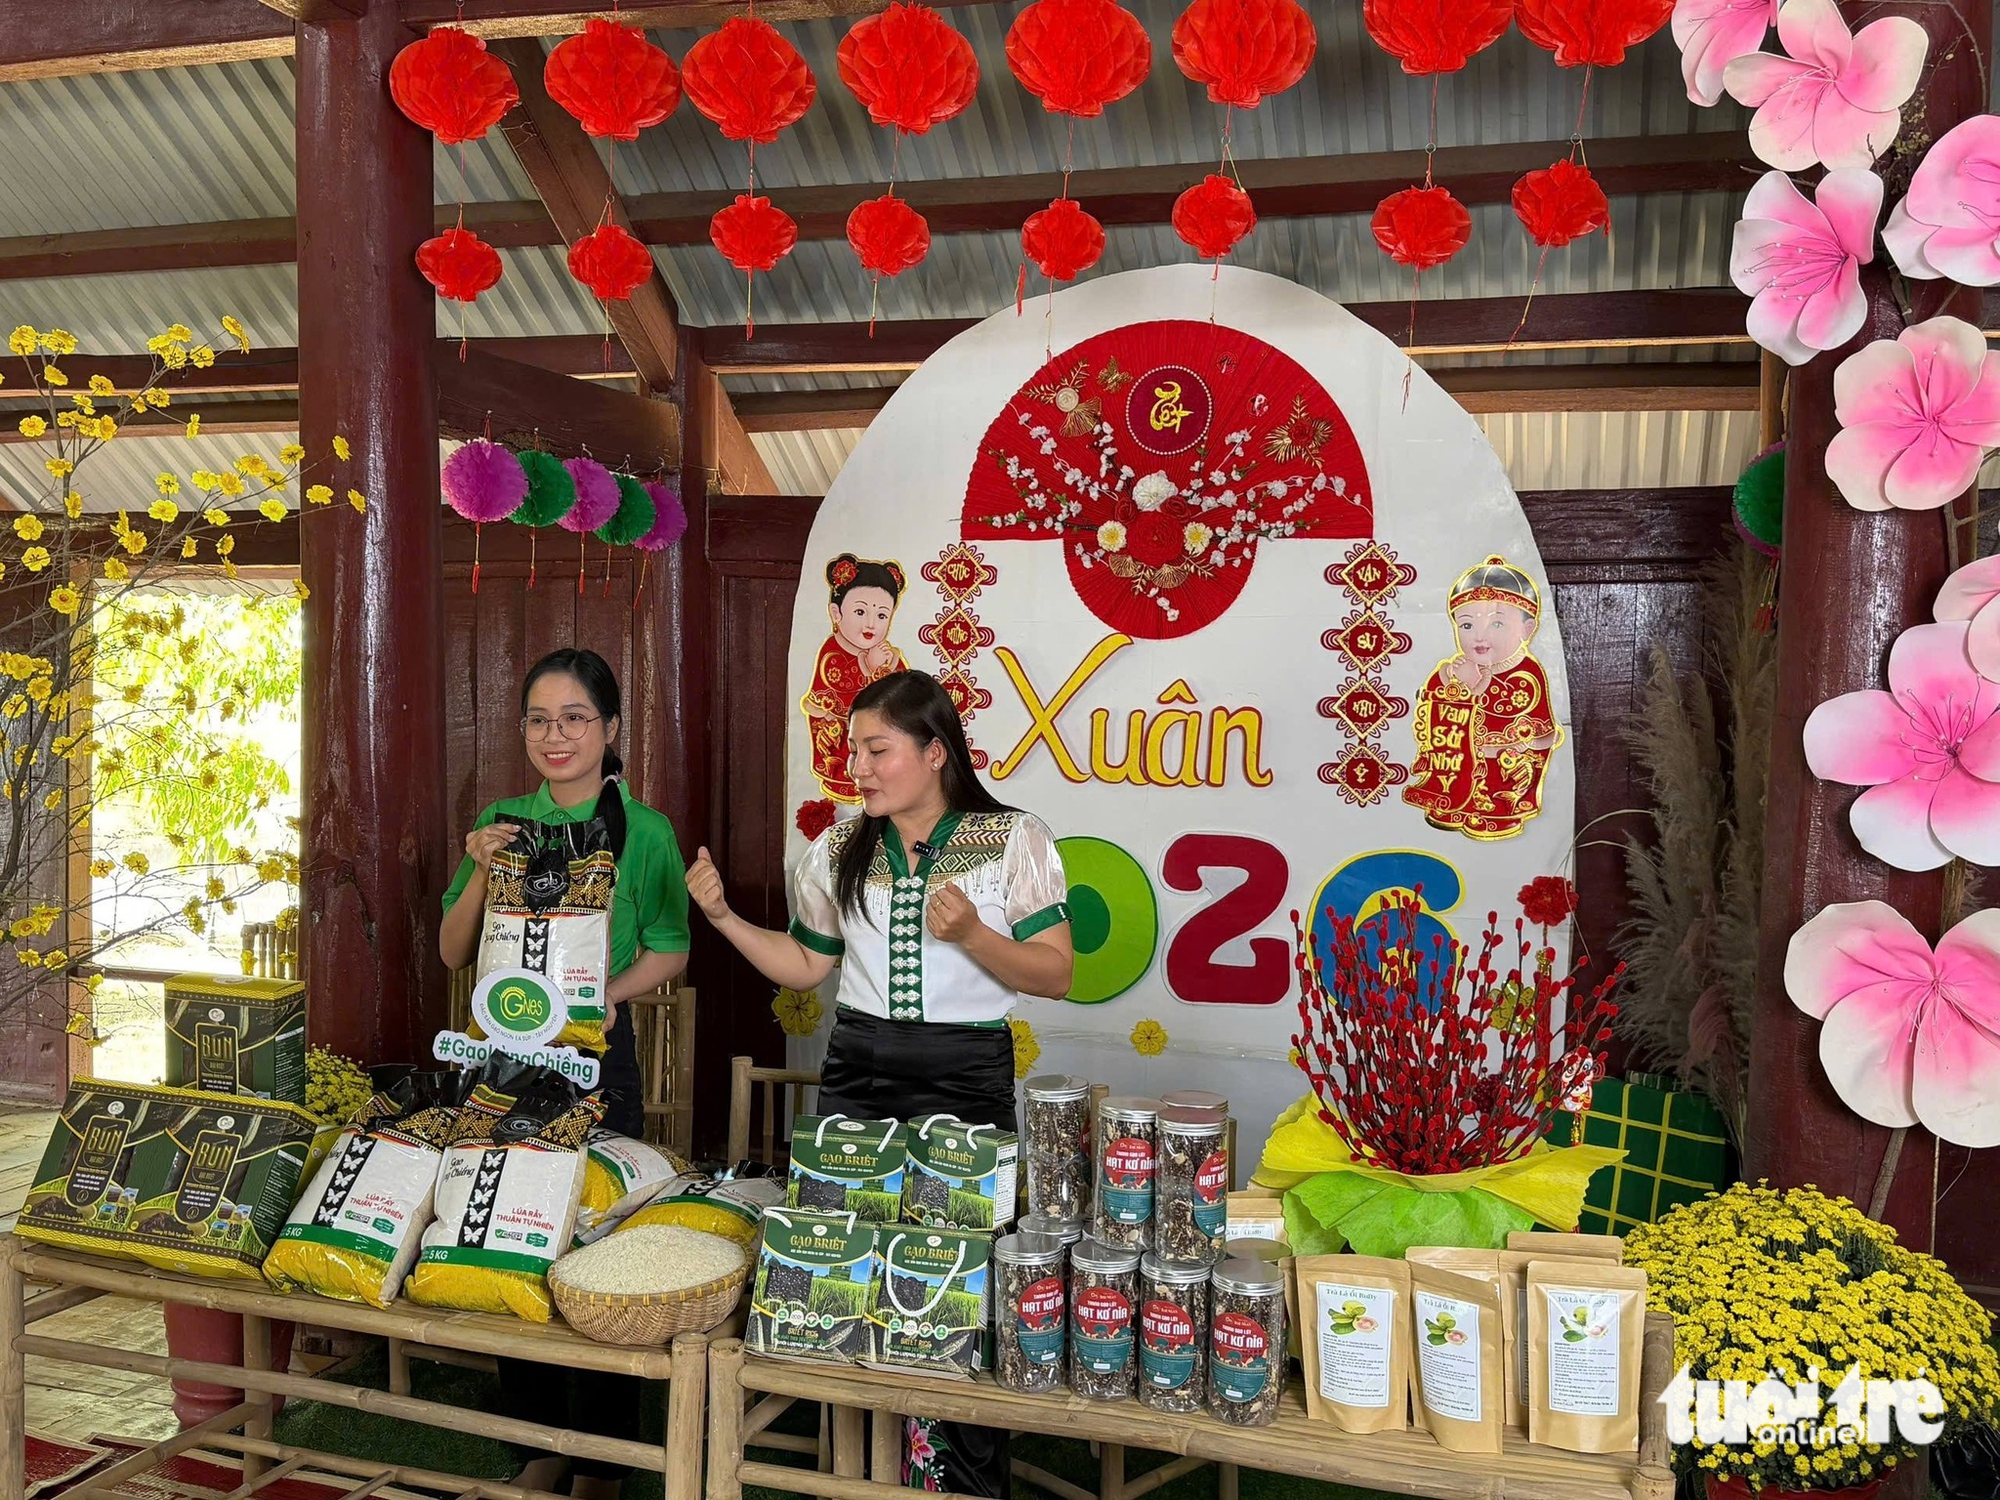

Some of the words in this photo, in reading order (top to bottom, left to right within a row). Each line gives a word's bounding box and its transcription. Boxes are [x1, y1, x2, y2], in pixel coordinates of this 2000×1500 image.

[947, 561, 971, 582] CHÚC
[1356, 563, 1381, 587] VẠN
[990, 631, 1273, 788] Xuân
[1429, 753, 1464, 772] Như
[1437, 772, 1458, 794] Ý
[1055, 832, 1467, 1025] 026
[202, 1031, 233, 1061] BÚN
[89, 1124, 123, 1155] BÚN
[196, 1140, 233, 1170] BÚN
[820, 1153, 843, 1166] GẠO
[1106, 1156, 1124, 1171] HẠT
[1199, 1173, 1216, 1188] HẠT
[512, 1207, 528, 1217] LÚA
[496, 1214, 522, 1225] THUẬN
[522, 1217, 533, 1227] TỰ
[533, 1220, 555, 1231] NHIÊN
[285, 1228, 291, 1237] 5
[291, 1227, 303, 1237] KG
[790, 1235, 812, 1249] GẠO
[429, 1250, 435, 1260] 5
[435, 1251, 449, 1261] KG
[904, 1245, 927, 1259] GẠO
[1325, 1288, 1338, 1296] Trà
[1022, 1301, 1041, 1315] HẠT
[1078, 1305, 1096, 1320] HẠT
[1214, 1327, 1230, 1344] HẠT
